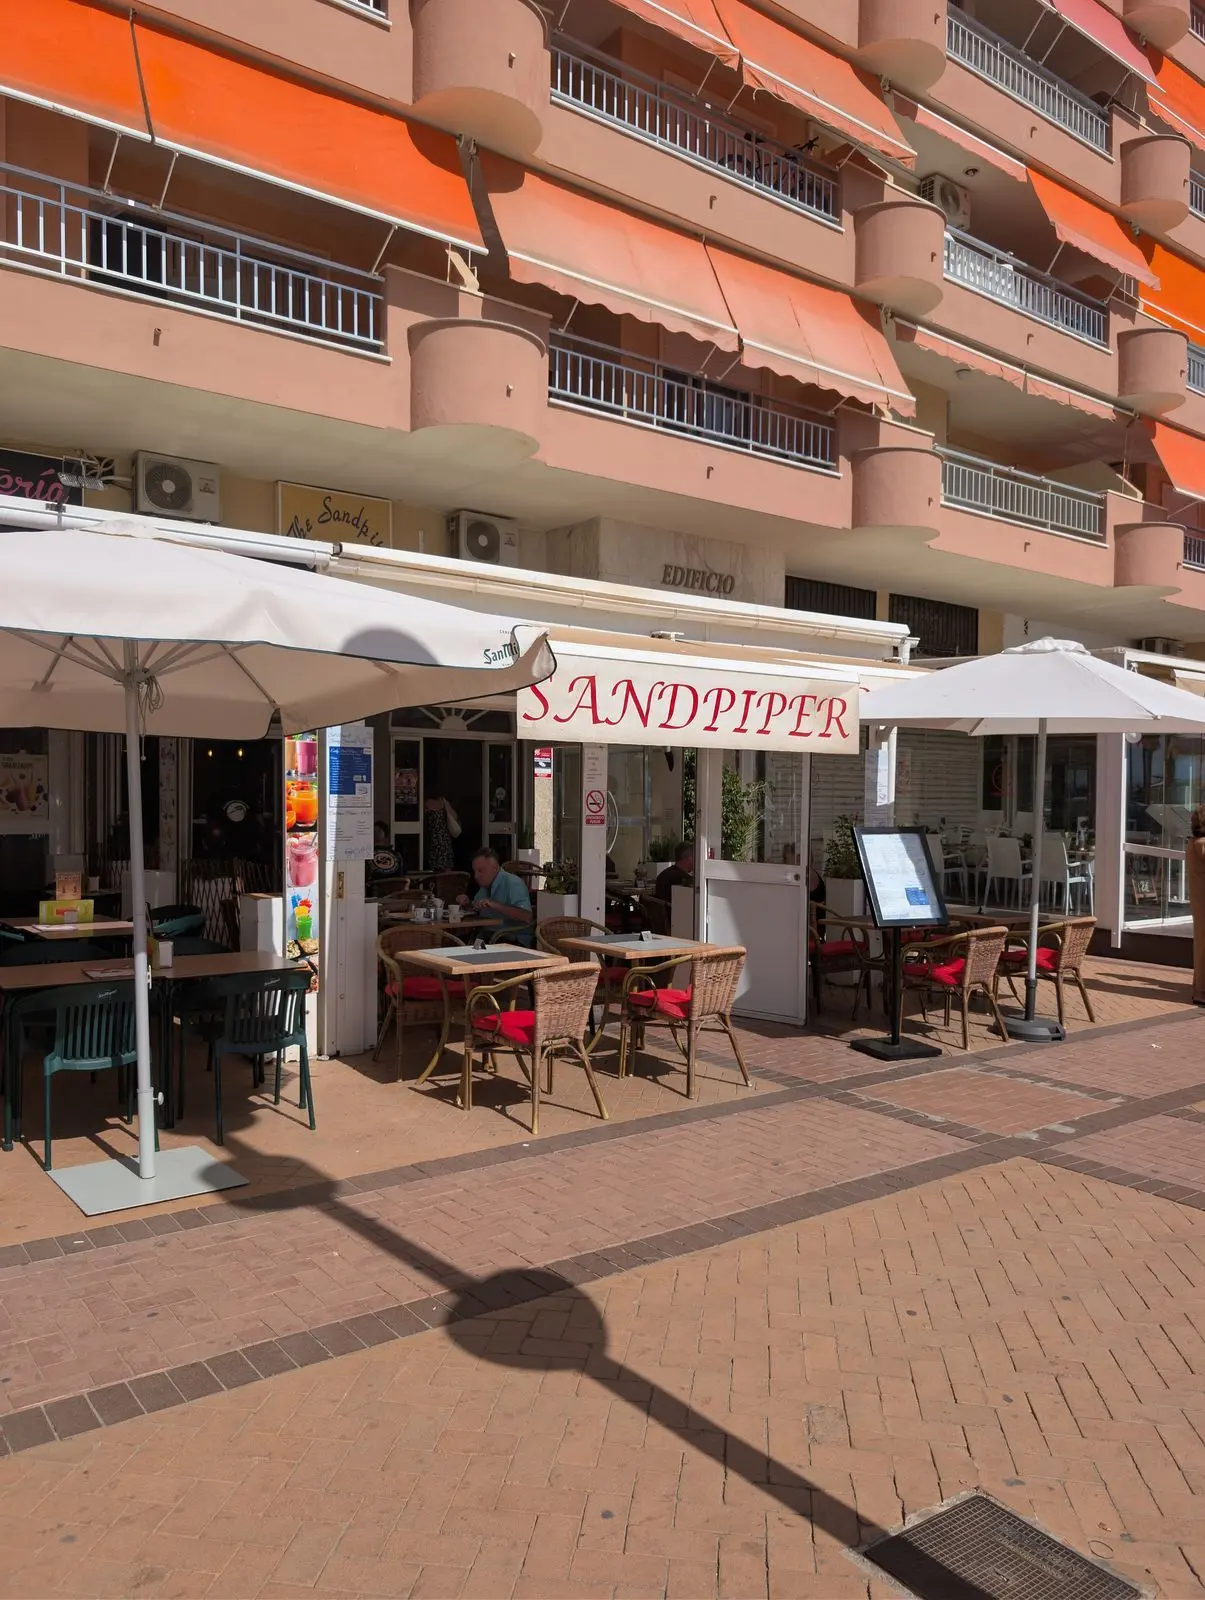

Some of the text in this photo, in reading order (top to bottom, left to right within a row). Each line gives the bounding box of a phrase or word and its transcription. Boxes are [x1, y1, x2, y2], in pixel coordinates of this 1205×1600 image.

[0, 468, 64, 503] ería
[317, 495, 384, 546] Sandpi
[661, 564, 736, 594] EDIFICIO
[522, 675, 850, 739] SANDPIPER
